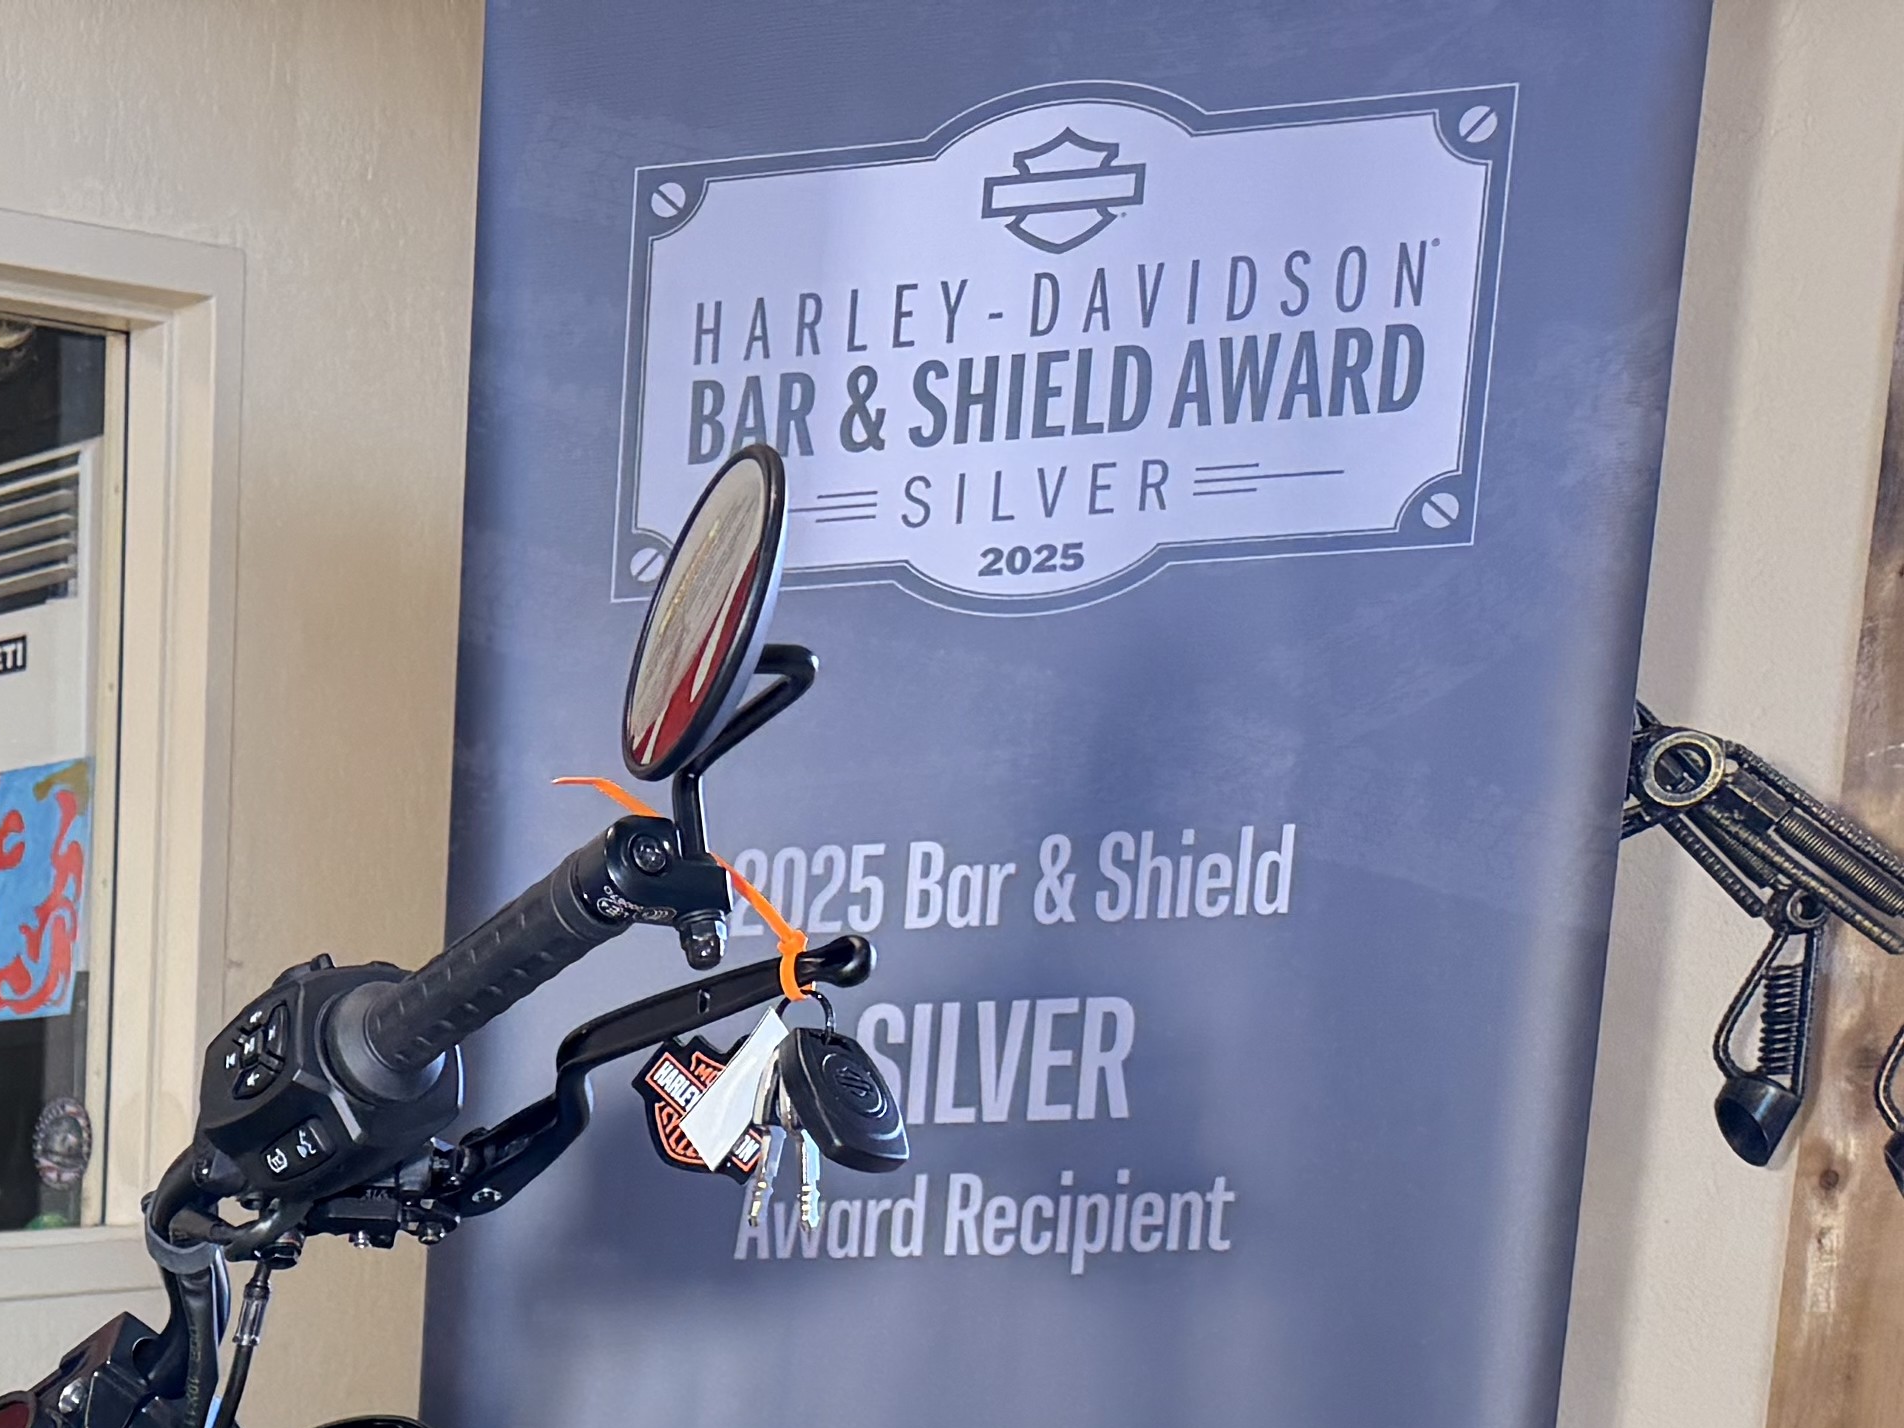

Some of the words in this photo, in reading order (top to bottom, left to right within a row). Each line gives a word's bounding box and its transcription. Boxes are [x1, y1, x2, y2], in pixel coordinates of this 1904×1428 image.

[691, 238, 1429, 365] HARLEY-DAVIDSON
[688, 369, 816, 465] BAR
[839, 363, 886, 453] &
[908, 341, 1153, 448] SHIELD
[1168, 322, 1425, 429] AWARD
[900, 458, 1170, 529] SILVER
[977, 541, 1085, 578] 2025
[727, 841, 886, 937] 2025
[903, 840, 1014, 931] Bar
[1035, 832, 1076, 926] &
[1094, 823, 1297, 923] Shield
[853, 995, 1136, 1126] SILVER
[733, 1178, 925, 1262] Award
[942, 1173, 1235, 1275] Recipient
